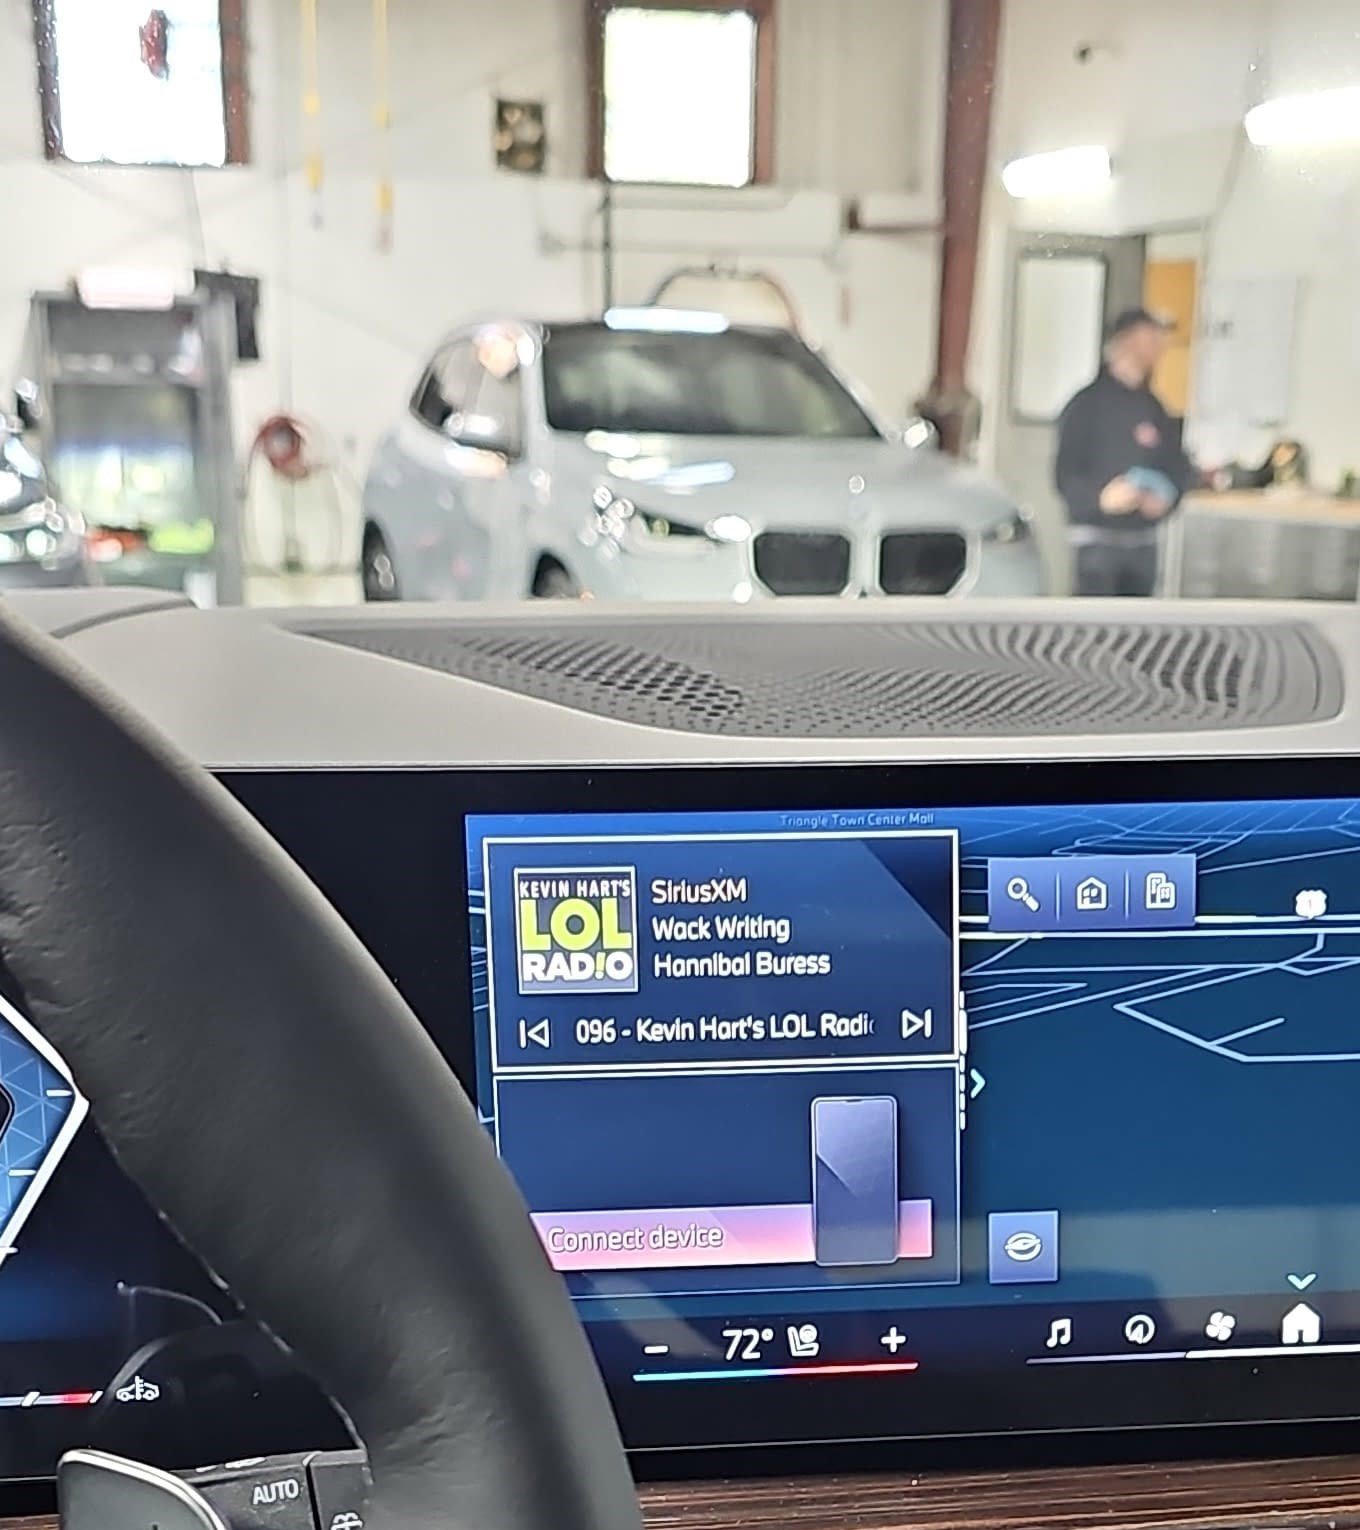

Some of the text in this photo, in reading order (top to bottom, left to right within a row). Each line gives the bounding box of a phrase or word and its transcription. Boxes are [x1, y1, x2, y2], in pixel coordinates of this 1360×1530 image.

[780, 812, 934, 828] Triangle Town Center Mall
[520, 880, 630, 897] KEVIN HART'S
[651, 878, 747, 903] SiriusXM
[521, 897, 632, 951] LOL
[652, 915, 790, 943] Wack Writing
[654, 953, 830, 977] Hannibal Buress
[576, 1019, 616, 1043] 096
[637, 1017, 694, 1041] Kevin
[700, 1015, 765, 1040] Hart's
[770, 1015, 815, 1038] LOL
[548, 1224, 723, 1252] Connect device
[723, 1328, 774, 1360] 72°
[253, 1479, 299, 1505] AUTO
